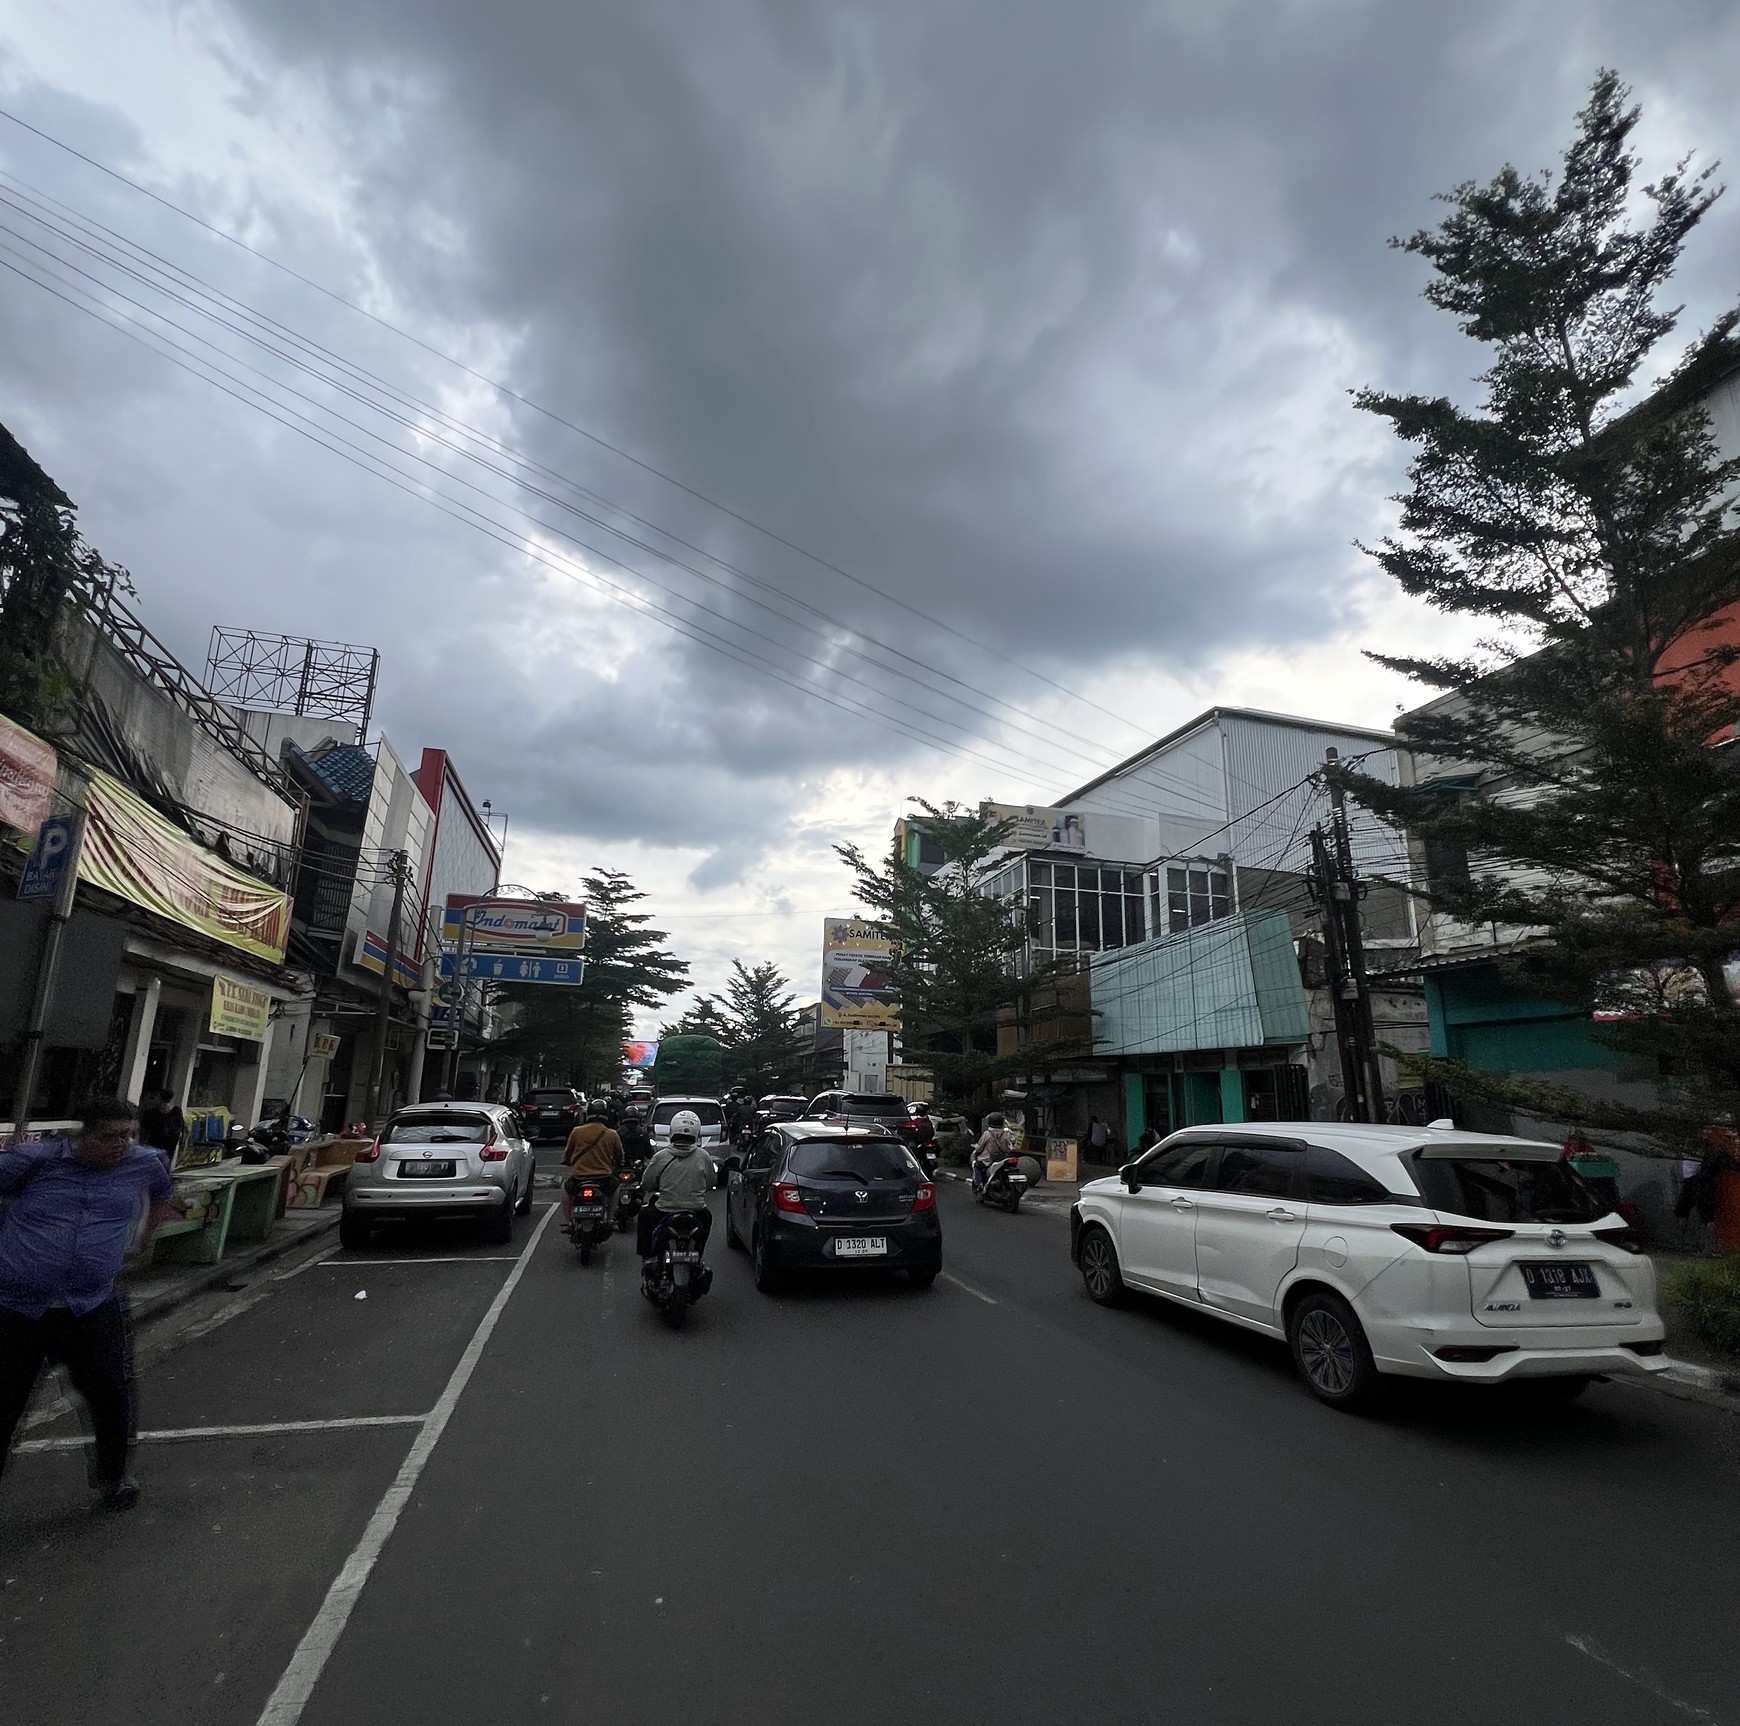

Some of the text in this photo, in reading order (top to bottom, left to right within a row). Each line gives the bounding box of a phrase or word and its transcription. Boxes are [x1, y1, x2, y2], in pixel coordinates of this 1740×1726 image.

[39, 828, 67, 870] P
[26, 868, 56, 882] BAYAR
[849, 929, 889, 941] SAMITE
[837, 1238, 885, 1249] D 1320 ALT
[1527, 1268, 1534, 1284] D
[1541, 1267, 1566, 1284] 1318
